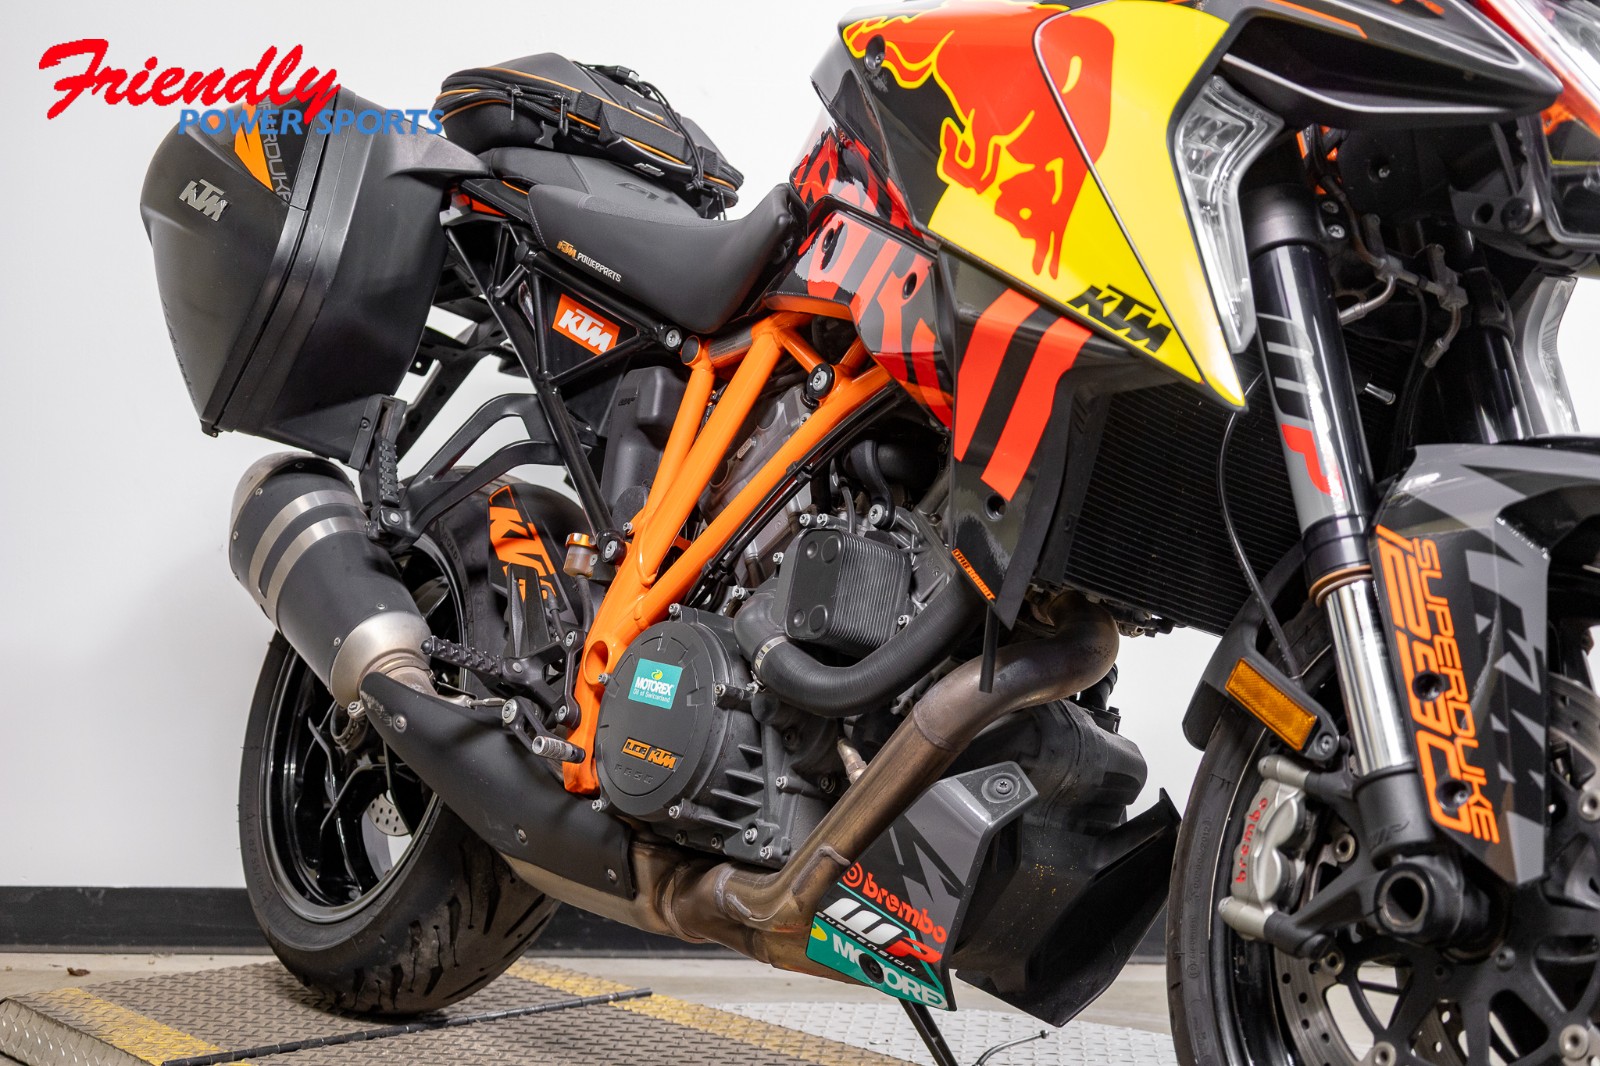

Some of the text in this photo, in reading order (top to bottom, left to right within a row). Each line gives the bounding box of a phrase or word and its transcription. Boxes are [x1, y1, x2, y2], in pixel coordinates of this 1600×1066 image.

[179, 178, 228, 222] KTM
[557, 240, 577, 259] KTM
[558, 309, 612, 353] KTM
[1066, 285, 1172, 353] KTM
[635, 677, 673, 696] MOTOREX
[647, 748, 677, 770] KTM
[1235, 798, 1268, 883] brembo
[862, 872, 947, 944] brembo
